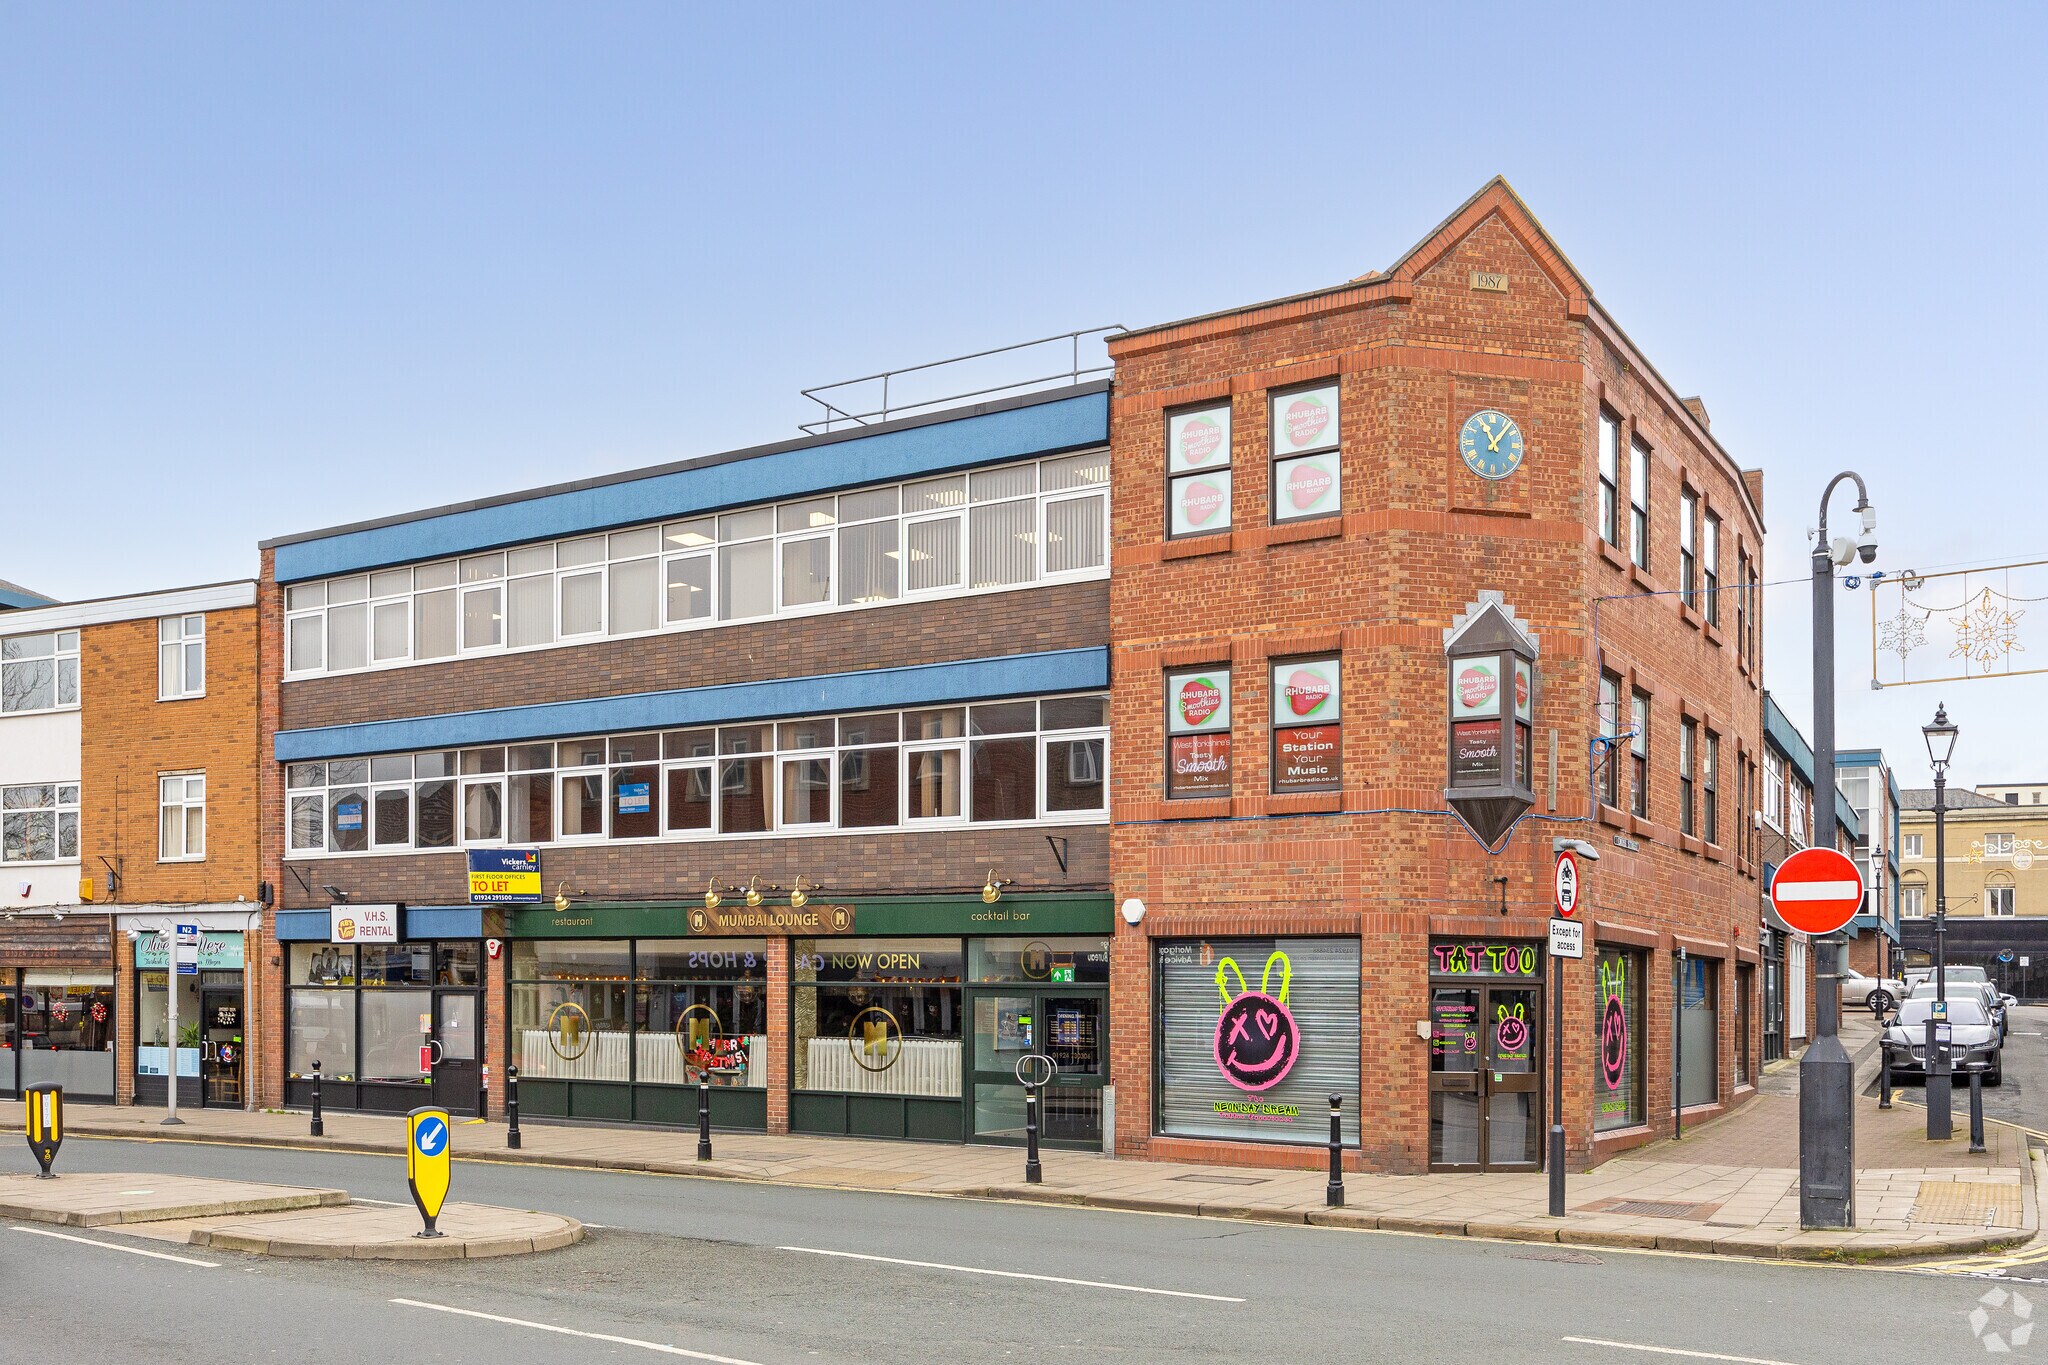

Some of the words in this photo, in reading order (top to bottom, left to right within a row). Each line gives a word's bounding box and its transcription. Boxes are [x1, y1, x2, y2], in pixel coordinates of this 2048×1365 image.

[1477, 274, 1502, 289] 1987
[1286, 406, 1327, 421] RHUBARB
[1286, 415, 1327, 434] Smoothies
[1181, 426, 1220, 440] RHUBARB
[1294, 428, 1318, 438] RADIO
[1182, 435, 1220, 452] Smoothies
[1189, 446, 1212, 456] RADIO
[1286, 476, 1332, 491] RHUBARB
[1306, 486, 1324, 494] RADIO
[1181, 493, 1223, 508] RHUBARB
[1200, 503, 1217, 511] RADIO
[1458, 675, 1495, 685] RHUBARB
[1180, 688, 1220, 700] RHUBARB
[1285, 684, 1331, 697] RHUBARB
[1458, 682, 1495, 696] Smoothies
[1305, 693, 1323, 701] RADIO
[1466, 692, 1487, 700] RADIO
[1180, 696, 1220, 713] Smoothies
[1188, 708, 1211, 717] RADIO
[1293, 731, 1323, 740] Your
[1173, 741, 1193, 749] West
[1193, 738, 1230, 748] Yorkshire's
[1282, 742, 1333, 753] Station
[1458, 745, 1498, 760] Smooth
[1293, 754, 1323, 763] Your
[1176, 755, 1227, 774] Smooth
[1287, 766, 1328, 776] Music
[1278, 775, 1339, 785] rhubarbradio.co.uk
[501, 857, 527, 866] Vickers
[511, 864, 537, 872] carnley
[472, 881, 488, 892] TO
[491, 881, 509, 892] LET
[364, 911, 388, 921] V.H.S.
[718, 913, 767, 927] MUMBAI
[769, 913, 819, 927] LOUNGE
[971, 909, 1009, 920] cocktail
[1013, 910, 1030, 920] bar
[551, 916, 593, 926] restaurant
[182, 926, 192, 934] N2
[359, 926, 394, 936] RENTAL
[1552, 924, 1572, 938] Except
[1572, 927, 1581, 938] for
[140, 933, 169, 952] Olive
[1557, 941, 1576, 951] access
[832, 953, 873, 969] NOW
[877, 953, 919, 969] OPEN
[1433, 945, 1535, 974] TATTOO
[1213, 1101, 1240, 1113] NEON
[1240, 1102, 1260, 1115] DAY
[1262, 1103, 1300, 1117] DREAM
